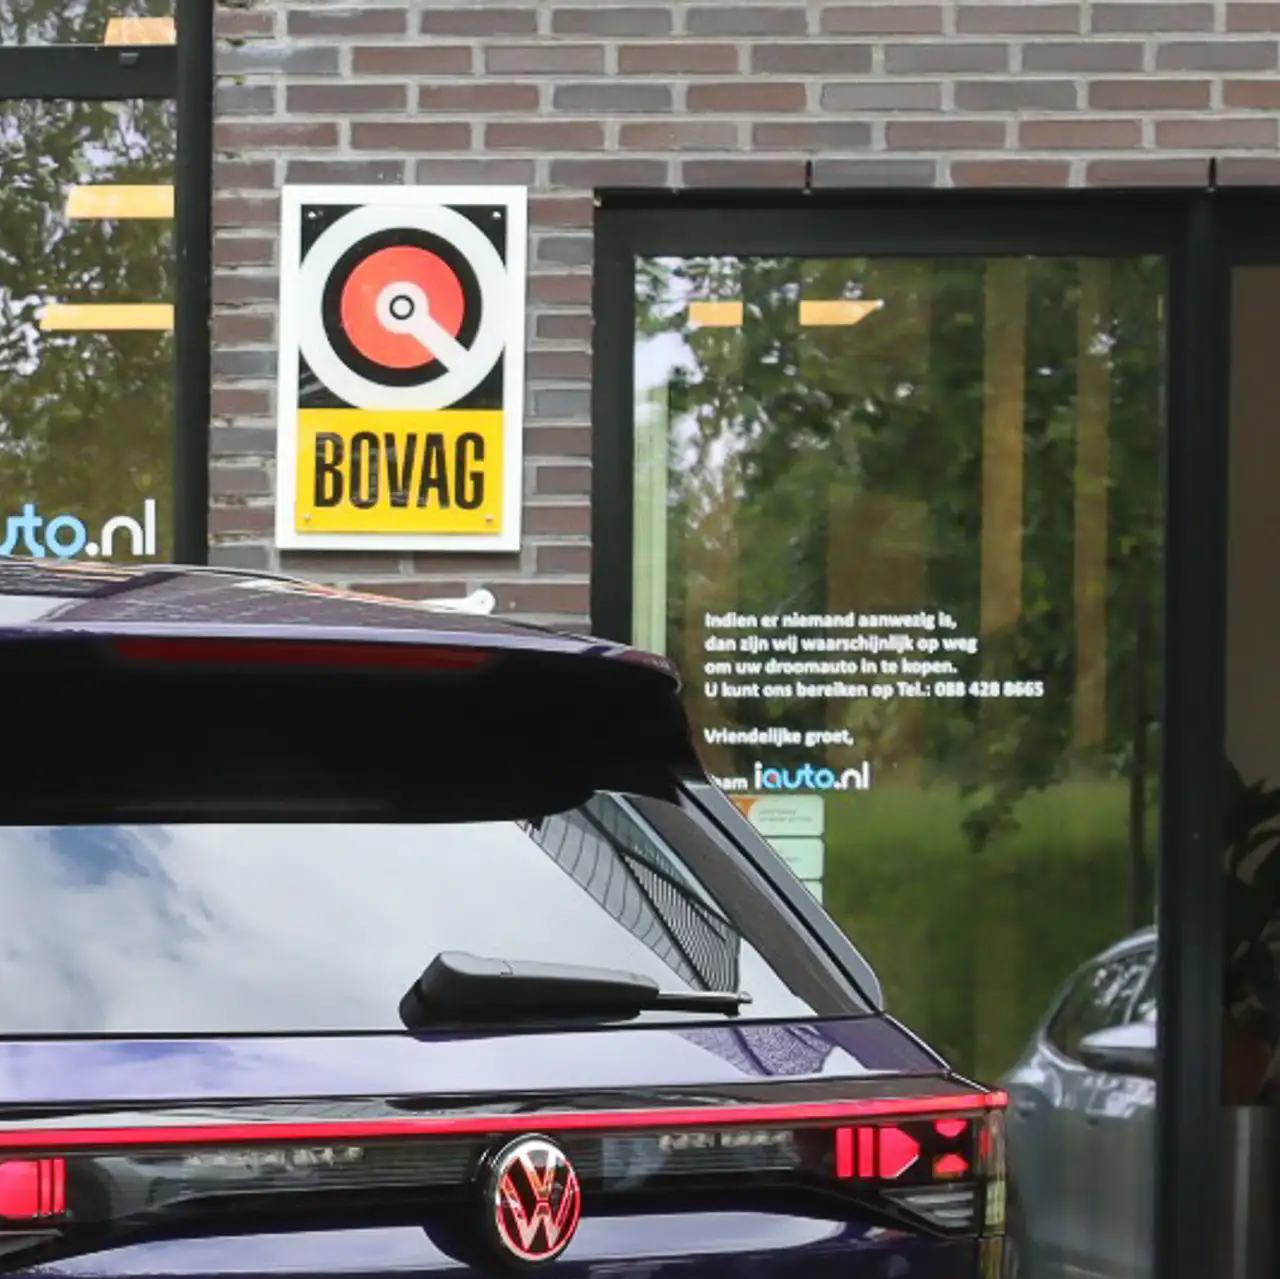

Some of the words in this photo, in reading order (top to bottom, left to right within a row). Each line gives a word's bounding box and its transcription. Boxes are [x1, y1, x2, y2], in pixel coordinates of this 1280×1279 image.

[313, 431, 485, 509] BOVAG
[705, 612, 757, 628] Indien
[761, 614, 779, 628] er
[782, 612, 855, 628] niemand
[858, 612, 935, 630] aanwezig
[704, 634, 736, 651] dan
[740, 635, 769, 654] zijn
[772, 635, 798, 654] wij
[801, 634, 914, 654] waarschijnlijk
[916, 637, 939, 654] op
[942, 637, 978, 654] weg
[704, 661, 732, 674] om
[735, 661, 763, 674] uw
[765, 658, 858, 674] droomauto
[860, 657, 878, 674] in
[880, 660, 898, 674] te
[901, 657, 958, 677] kopen.
[704, 682, 719, 697] U
[721, 682, 760, 697] kunt
[762, 685, 793, 698] ons
[796, 681, 868, 697] bereiken
[871, 685, 894, 700] op
[703, 727, 802, 747] Vriendelijke
[753, 761, 870, 790] iauto.nl
